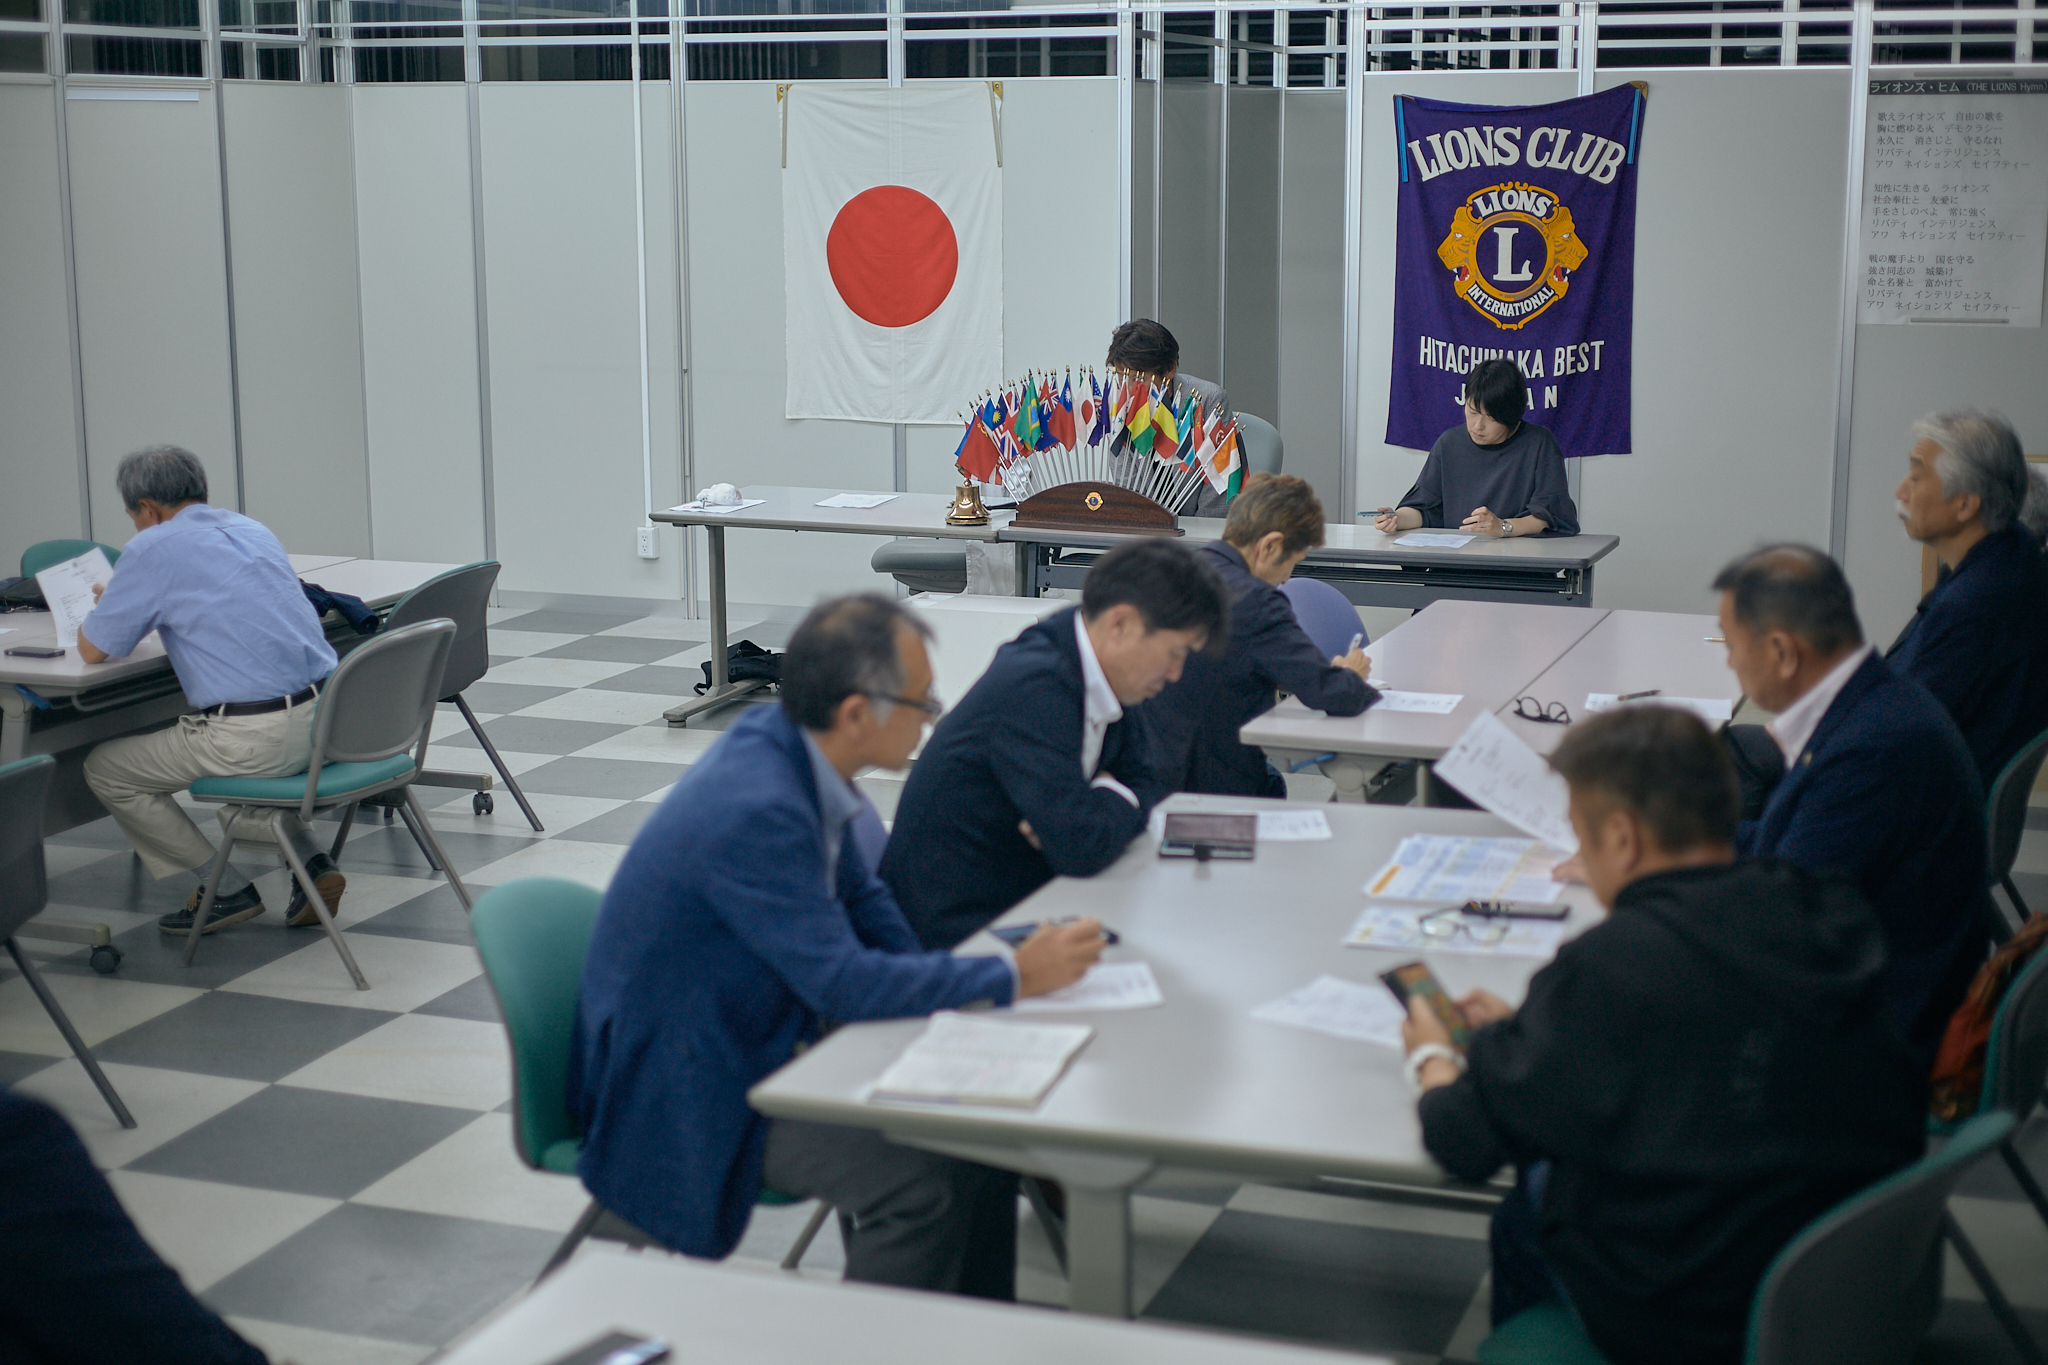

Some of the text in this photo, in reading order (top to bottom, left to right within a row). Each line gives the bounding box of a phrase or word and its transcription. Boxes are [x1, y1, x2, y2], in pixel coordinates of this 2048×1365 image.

[1991, 82, 2017, 91] LIONS
[1955, 112, 2004, 121] 自由の歌を
[1876, 124, 2003, 133] 胸に燃ゆる火 デモクラシー
[1876, 136, 2002, 145] 永久に 消さじと 守るなれ
[1408, 125, 1627, 184] LIONS CLUB
[1876, 148, 2001, 157] リバティ インテリジェンス
[1875, 159, 2031, 169] アワ ネイションズ セイフティー
[1874, 184, 1990, 193] 知性に生きる ライオンズ
[1474, 190, 1552, 217] LIONS
[1873, 195, 1958, 204] 社会奉仕と 友愛に
[1872, 207, 1987, 216] 手をさしのべよ 常に強く
[1872, 219, 1996, 228] リバティ インテリジェンス
[1871, 231, 2026, 241] アワ ネイションズ セイフティー
[1493, 227, 1533, 281] L
[1869, 254, 1974, 264] 戦の魔手より 国を守る
[1868, 267, 1954, 275] 強き同志の 城築け
[1867, 277, 1964, 287] 命と名誉と 富かけて
[1868, 289, 1991, 300] リバティ インテリジェンス
[1467, 283, 1555, 317] INTERNATIONAL
[1867, 300, 2021, 312] アワ ネイションズ セイフティー
[1553, 340, 1605, 377] BEST
